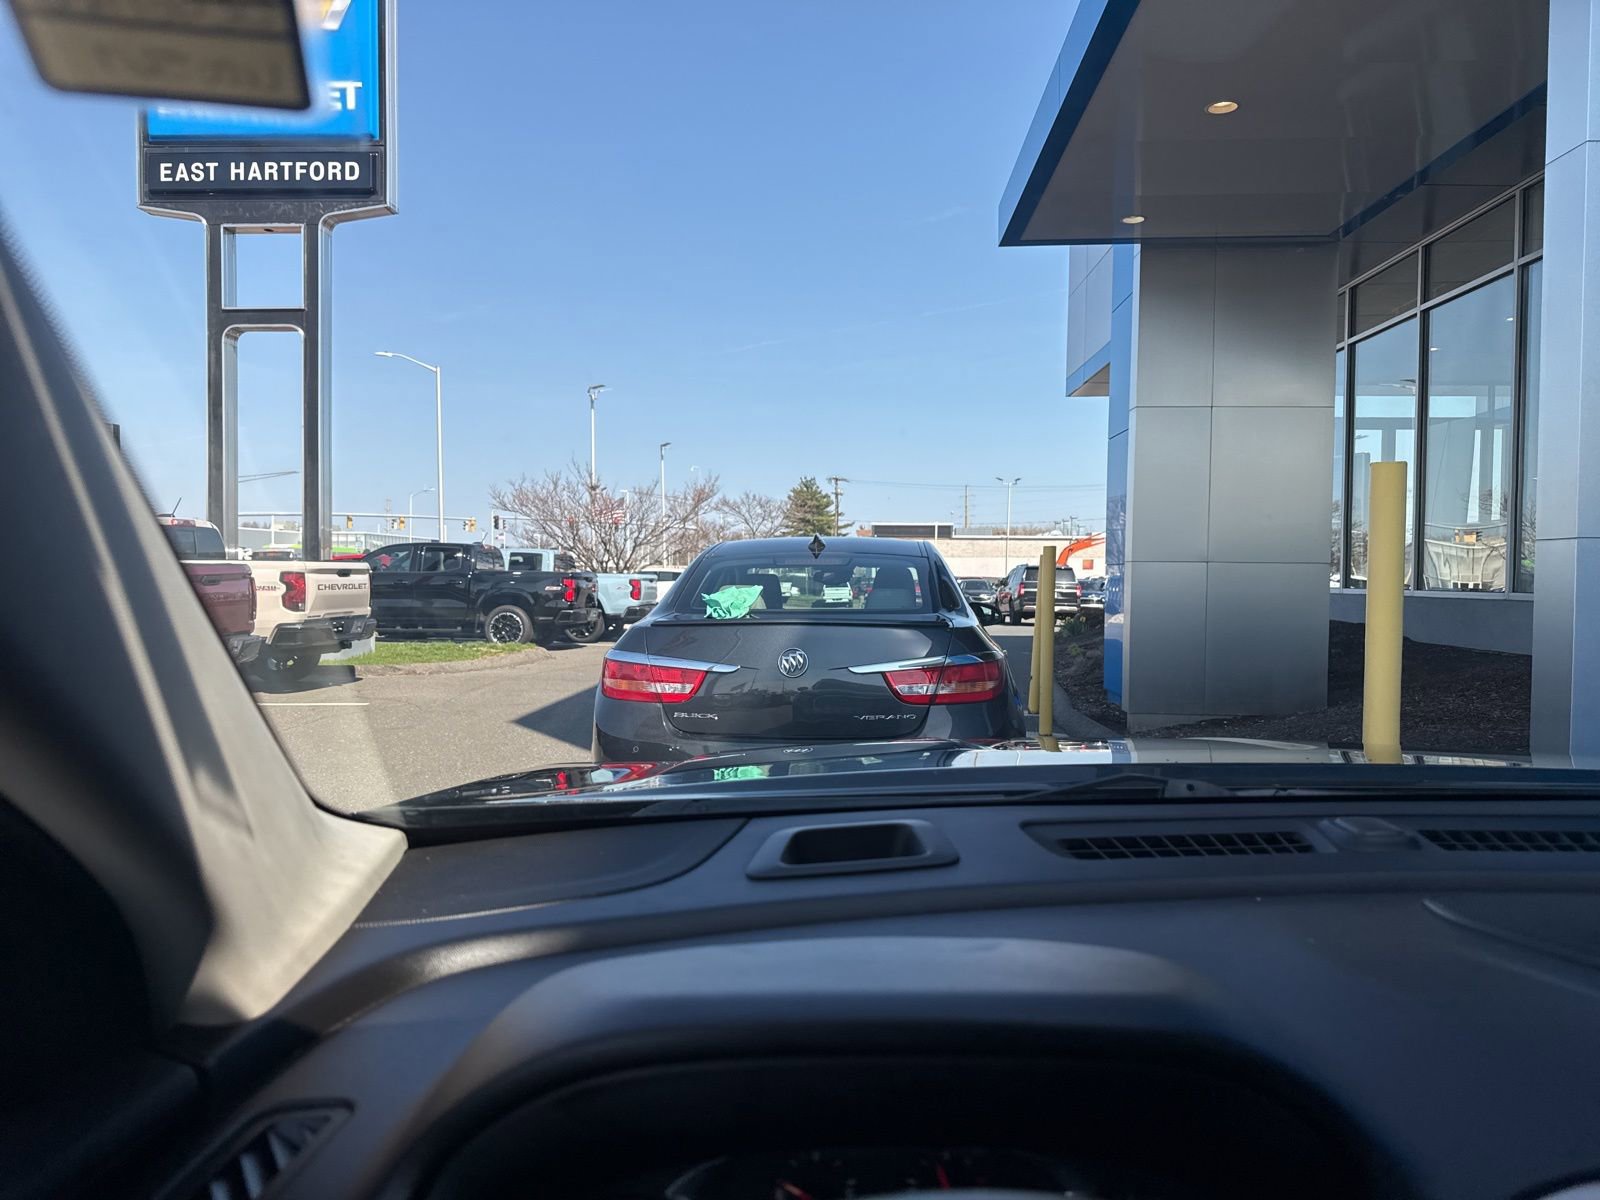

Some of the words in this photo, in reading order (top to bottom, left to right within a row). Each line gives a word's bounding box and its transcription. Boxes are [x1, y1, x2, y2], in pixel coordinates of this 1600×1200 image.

[159, 162, 218, 182] EAST
[230, 161, 360, 181] HARTFORD
[317, 582, 368, 591] CHEVROLET
[673, 711, 718, 720] BUICK
